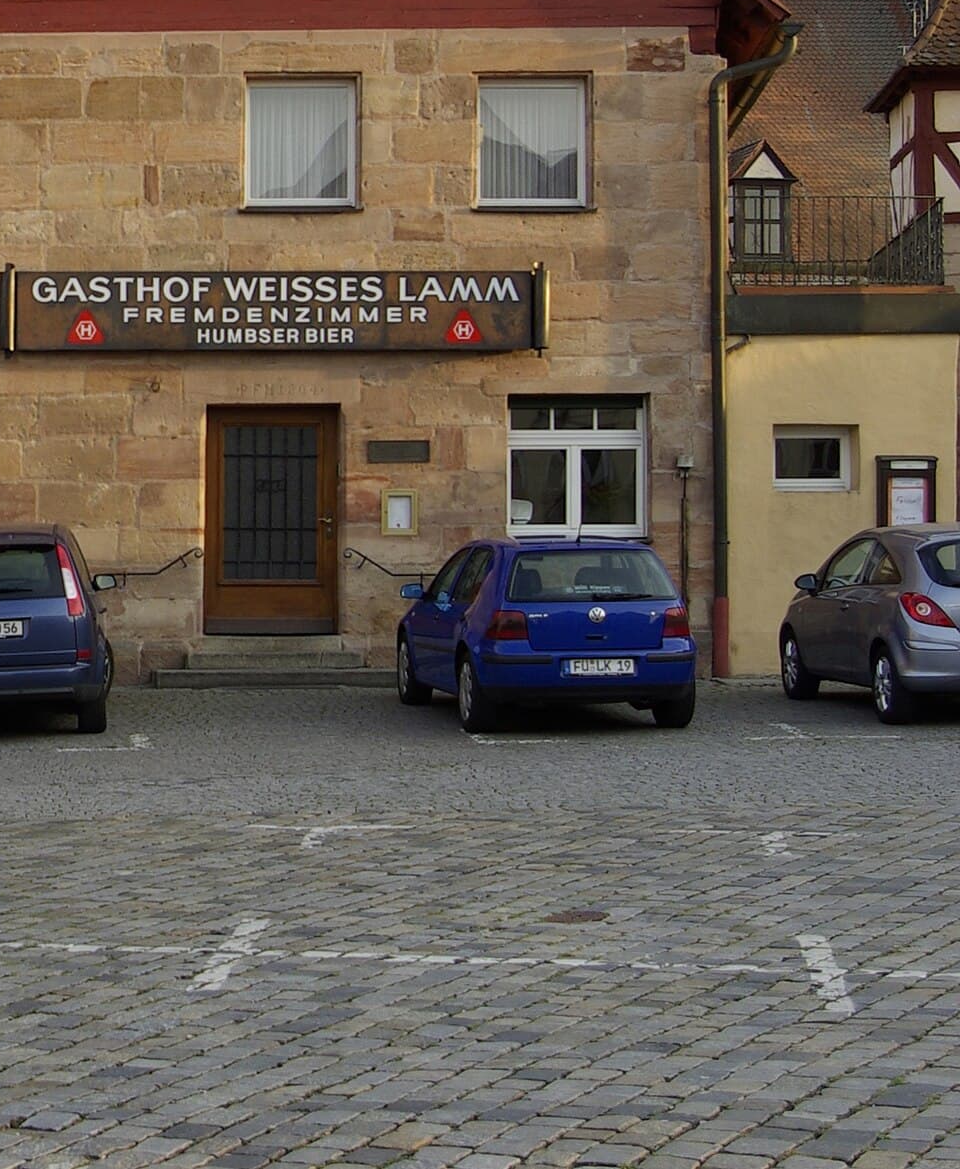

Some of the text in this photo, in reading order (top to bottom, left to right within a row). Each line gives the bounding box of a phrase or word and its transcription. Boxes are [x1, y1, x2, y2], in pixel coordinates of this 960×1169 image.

[32, 276, 520, 303] GASTHOF WEISSES LAMM
[123, 307, 428, 323] FREMDENZIMMER
[197, 328, 354, 344] HUMBSER BIER
